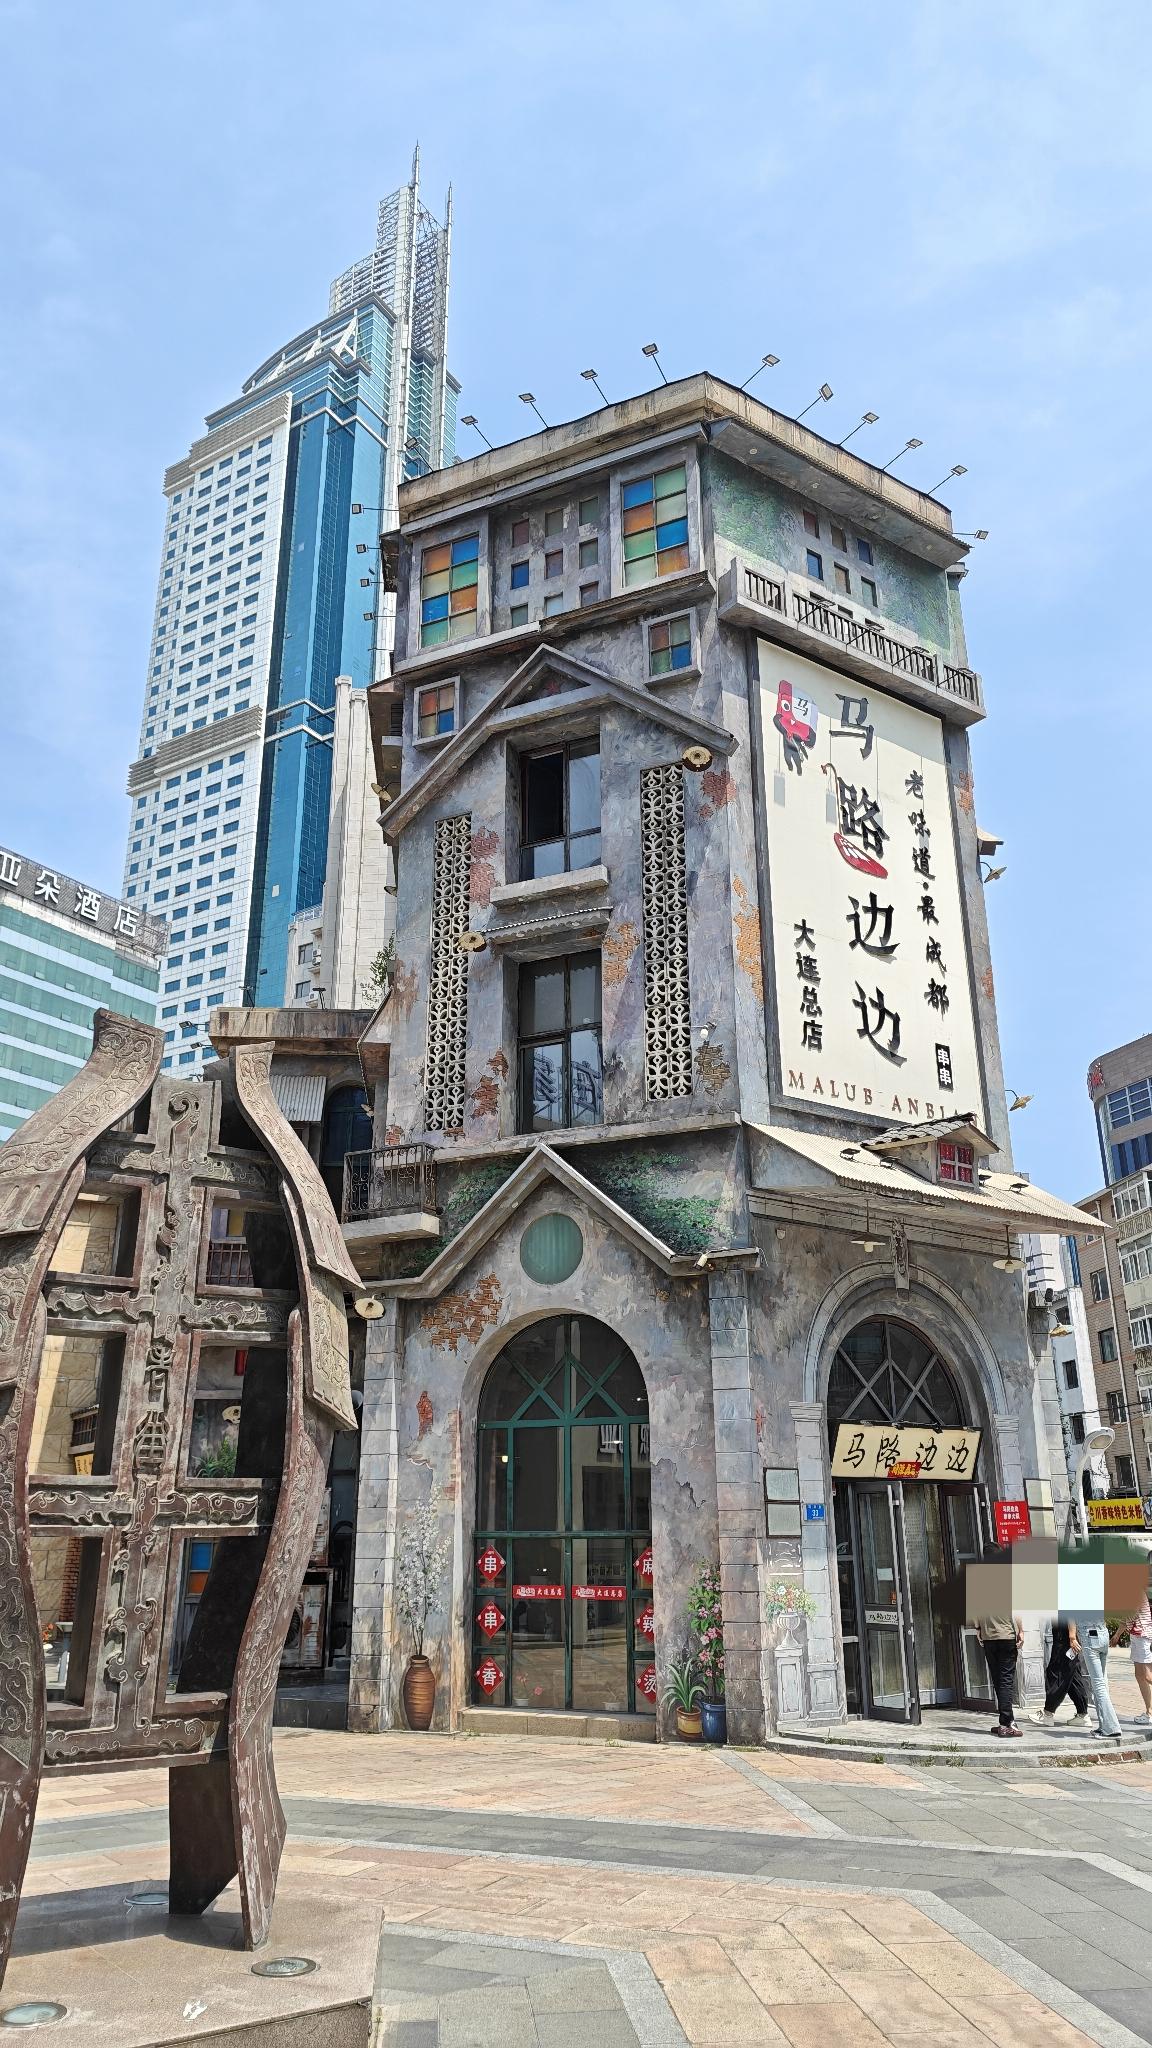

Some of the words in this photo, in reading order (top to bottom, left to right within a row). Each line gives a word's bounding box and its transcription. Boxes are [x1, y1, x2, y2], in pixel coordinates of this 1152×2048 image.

[794, 697, 809, 717] 马
[0, 850, 140, 938] 亚朵酒店
[829, 692, 908, 1068] 马路边边
[793, 918, 824, 1053] 大连总店
[937, 1048, 952, 1086] 串串
[842, 1430, 969, 1474] 马路边边
[811, 1509, 819, 1517] 33
[483, 1555, 498, 1574] 串
[484, 1610, 498, 1630] 串
[482, 1667, 497, 1687] 香
